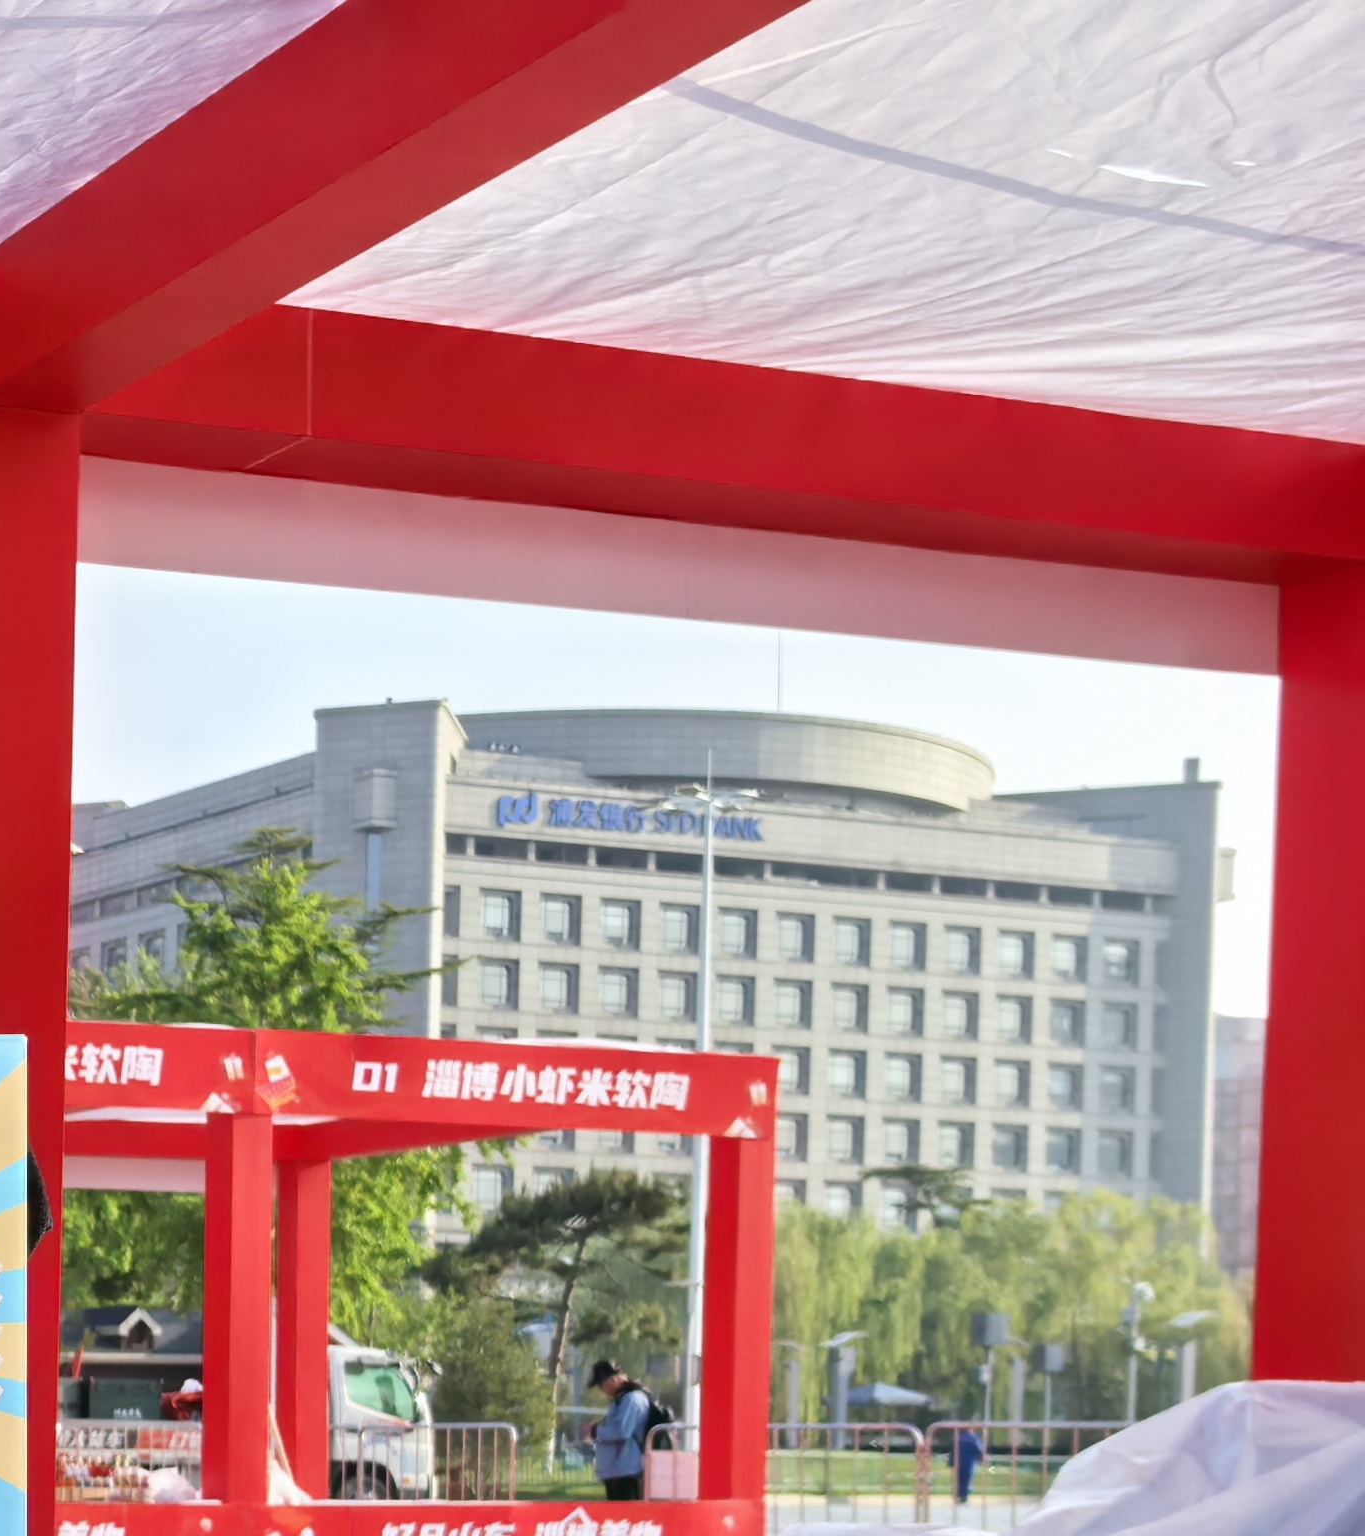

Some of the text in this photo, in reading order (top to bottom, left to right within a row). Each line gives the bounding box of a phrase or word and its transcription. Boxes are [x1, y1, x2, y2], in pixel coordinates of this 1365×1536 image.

[421, 1058, 690, 1112] 淄博小虾米软陶
